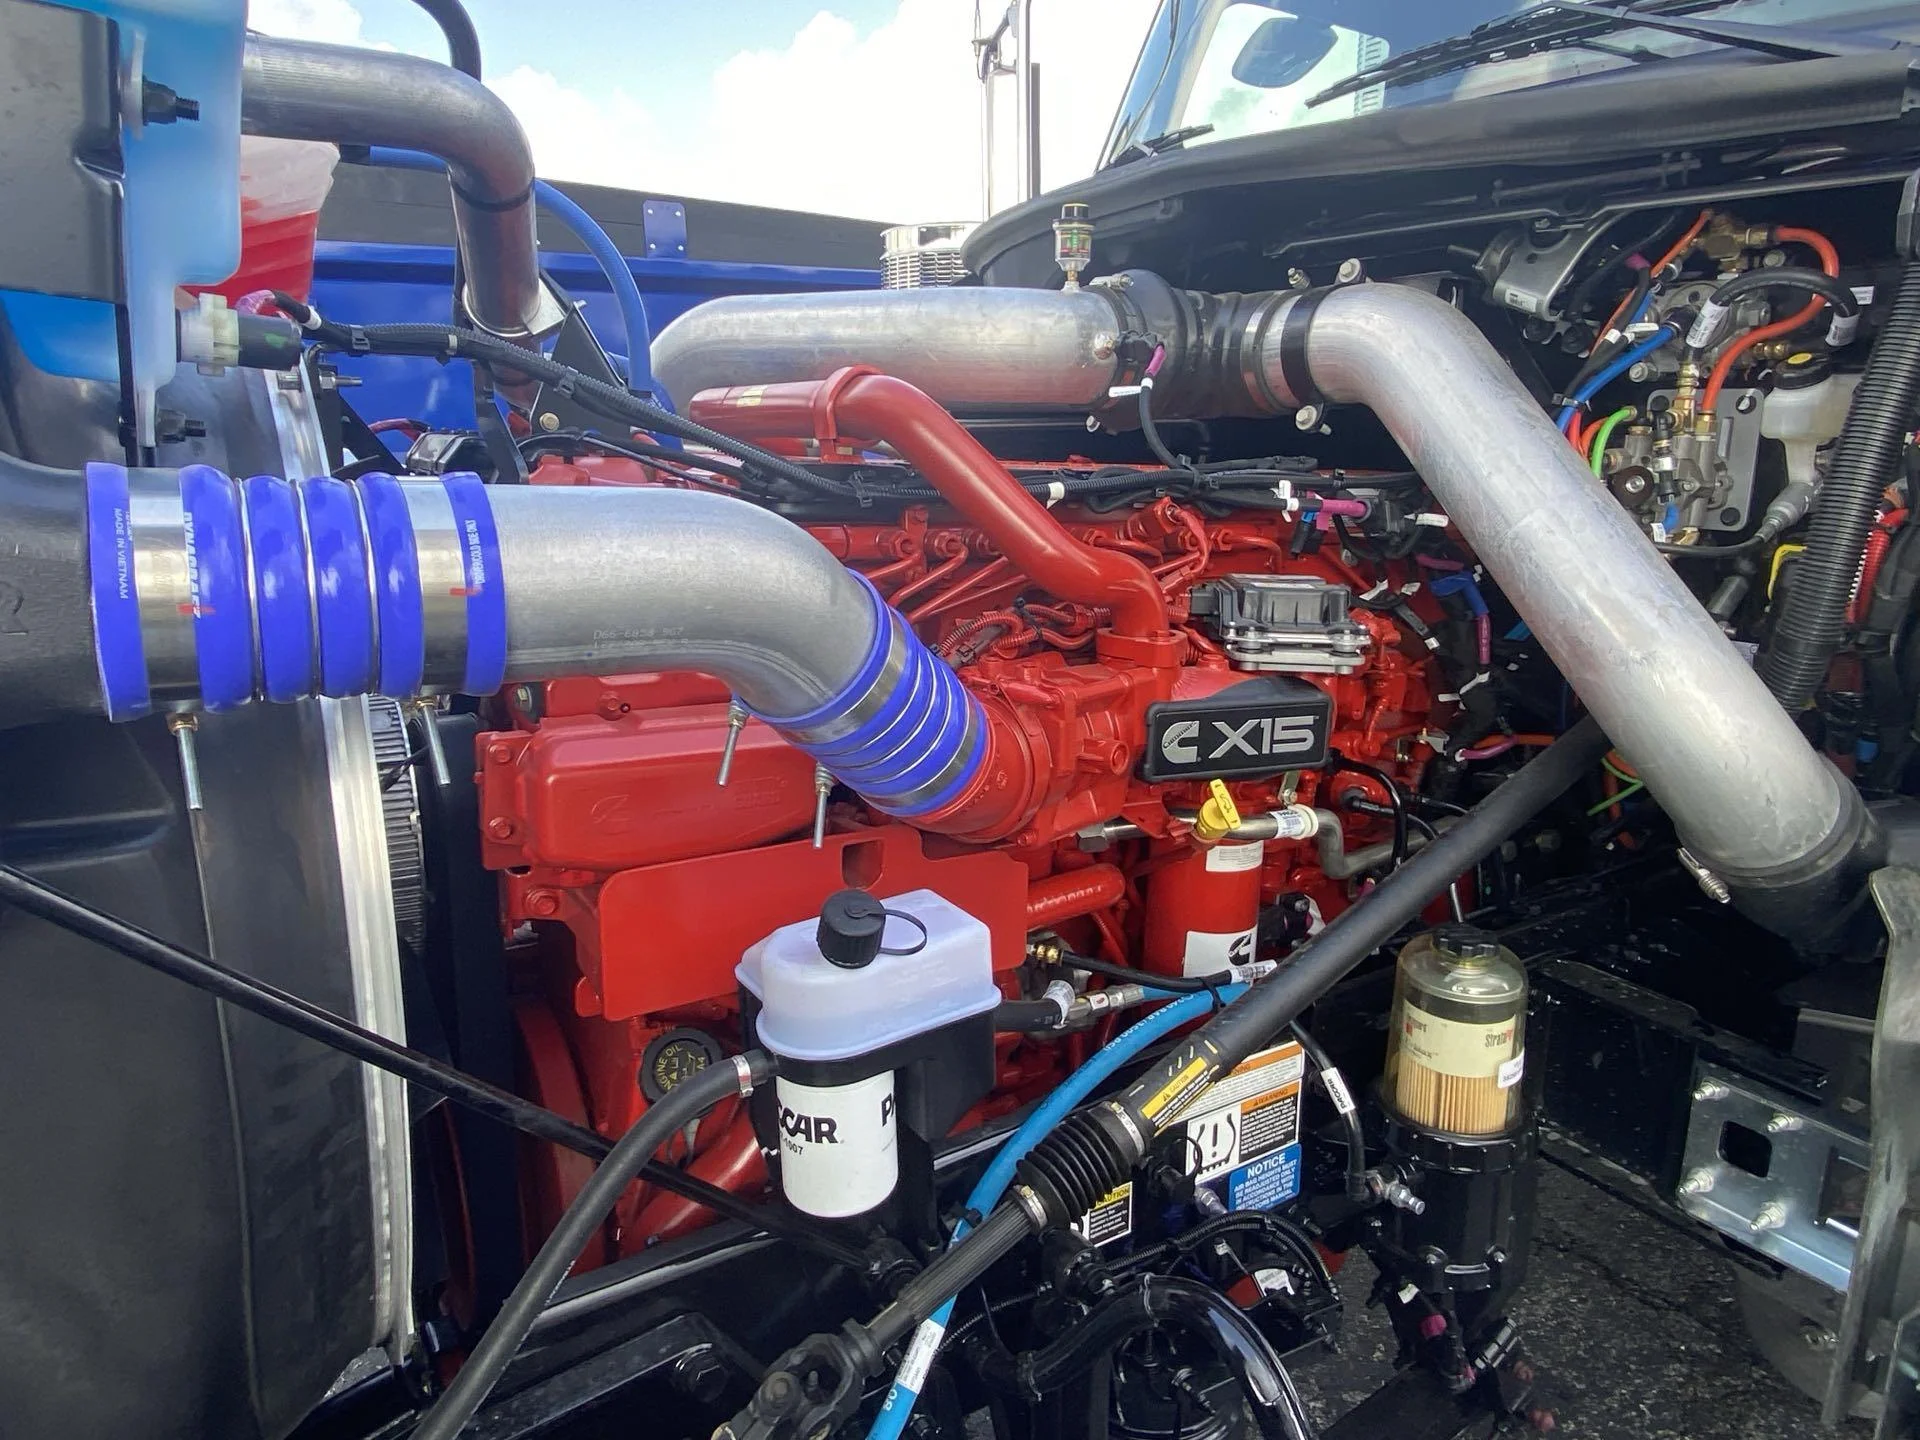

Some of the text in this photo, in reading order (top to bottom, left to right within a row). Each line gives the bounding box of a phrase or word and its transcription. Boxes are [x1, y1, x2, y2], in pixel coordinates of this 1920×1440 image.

[114, 508, 124, 537] MADE
[117, 538, 124, 549] IN
[118, 550, 129, 600] VIETNAM
[1208, 715, 1315, 759] X15
[656, 1043, 683, 1091] NGINE OIL
[780, 1106, 839, 1144] CAR
[1247, 1152, 1286, 1179] NOTICE
